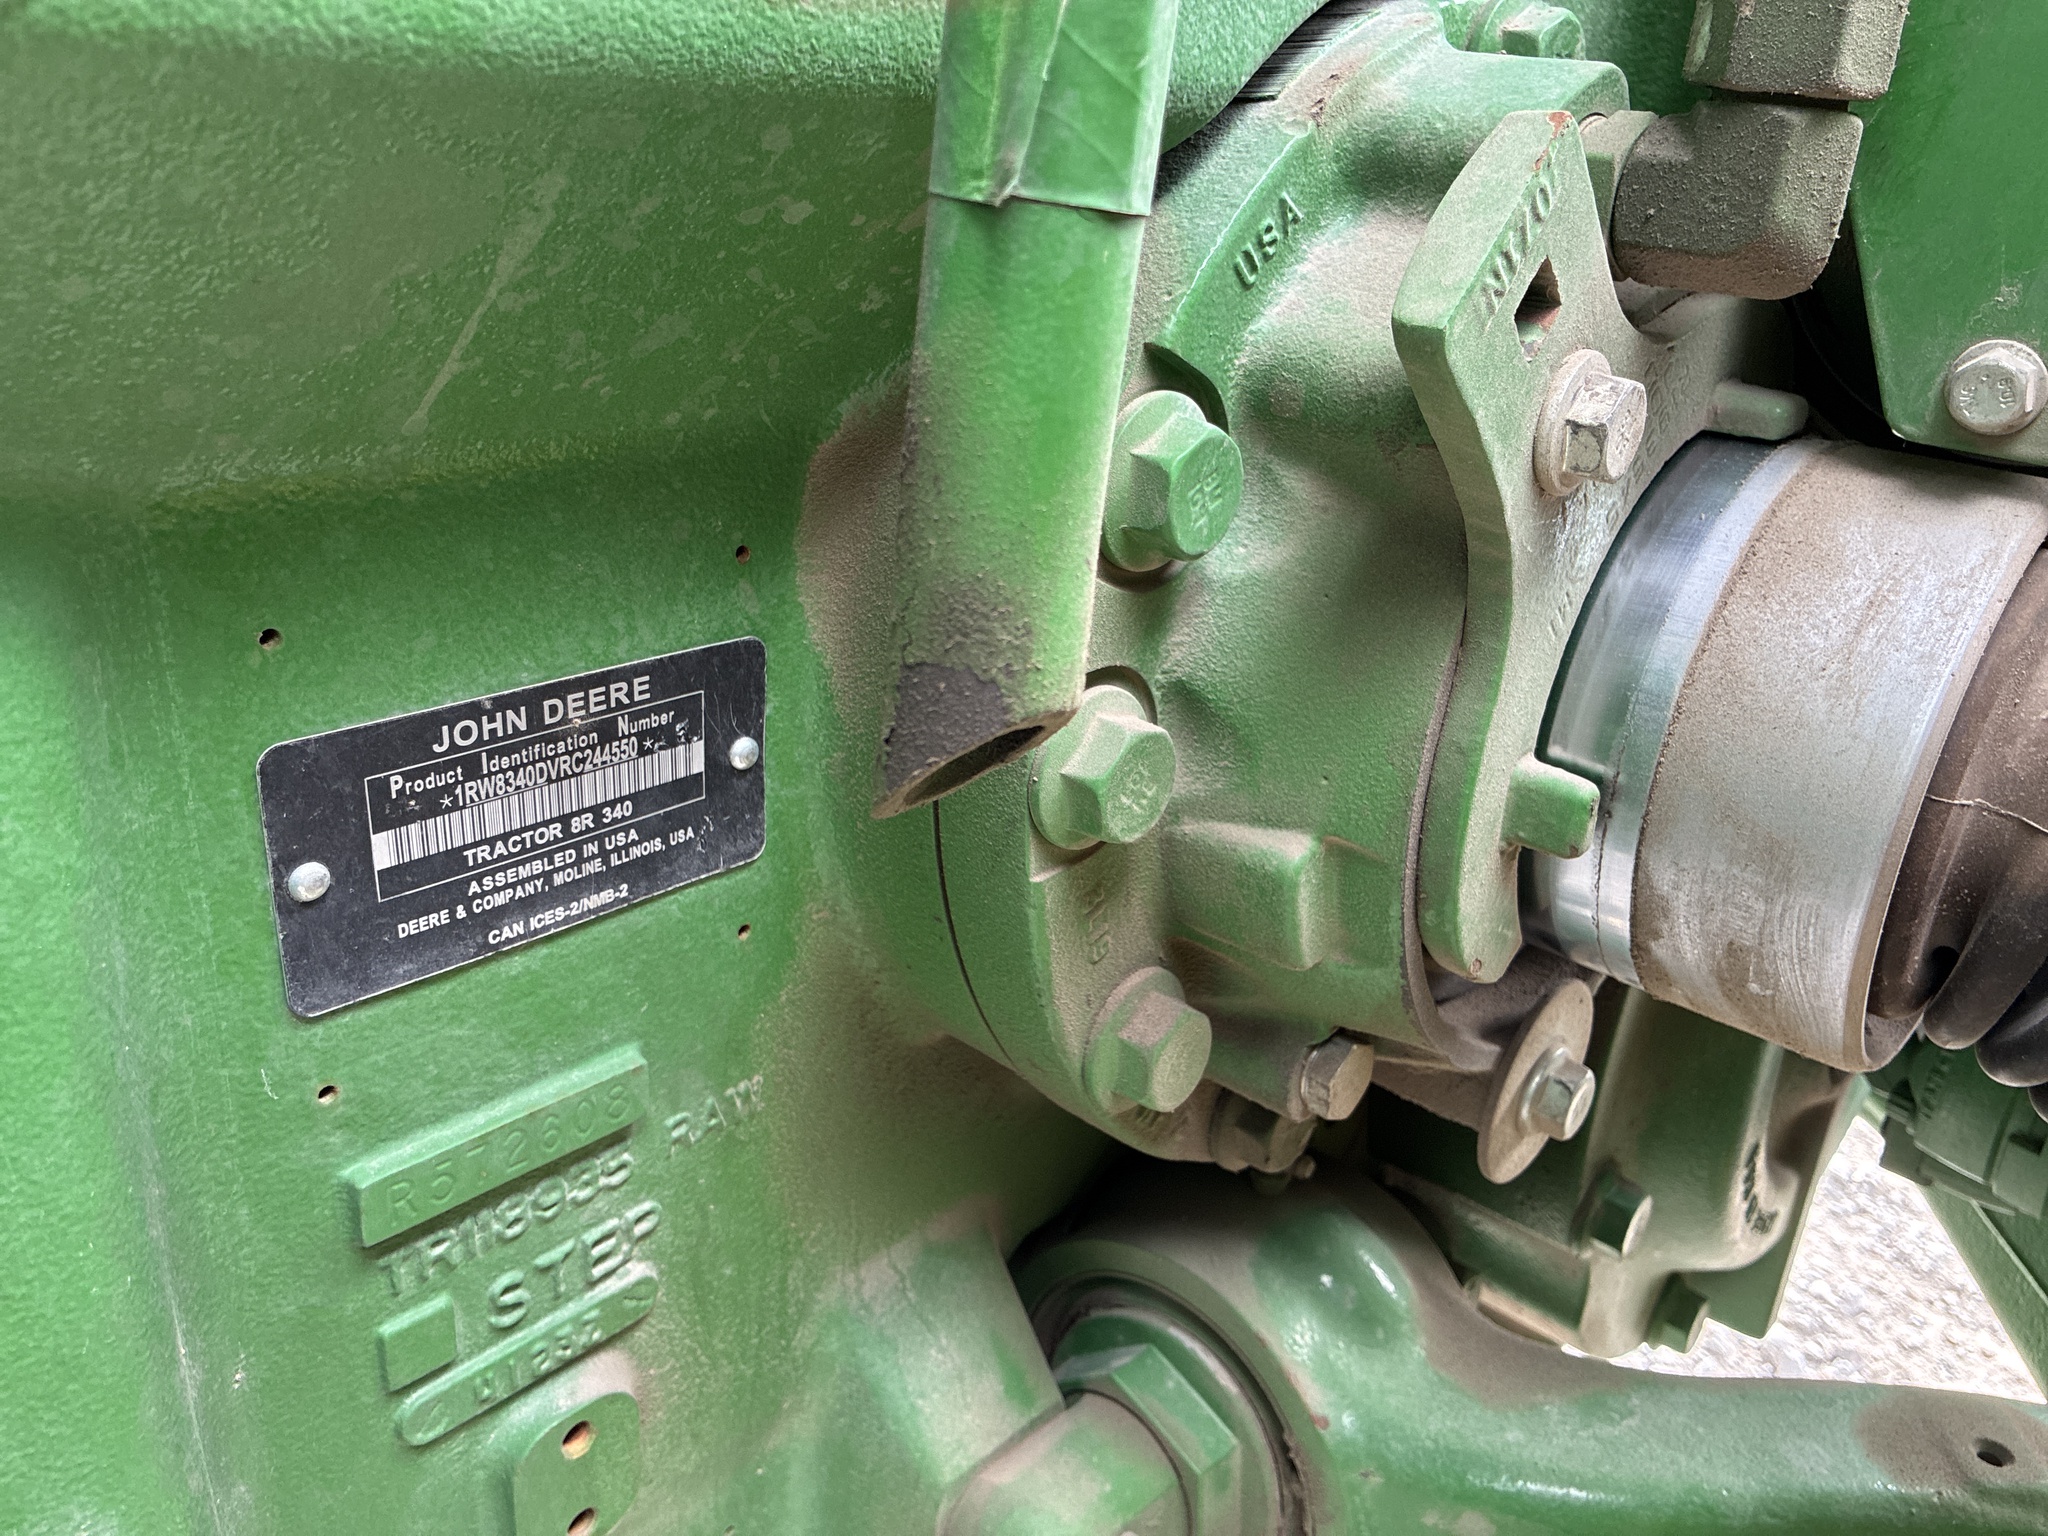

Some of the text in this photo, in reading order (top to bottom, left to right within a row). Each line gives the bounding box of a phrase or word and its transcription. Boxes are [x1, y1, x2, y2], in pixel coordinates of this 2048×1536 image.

[1233, 191, 1304, 290] USA
[389, 710, 675, 800] Product Identification Number
[432, 675, 651, 753] JOHN DEERE
[463, 800, 633, 867] TRACTOR 8R 340
[468, 828, 639, 896] ASSEMBLED IN USA
[398, 826, 695, 939] DEERE & COMPANY, MOLINE, ILLINOIS, USA
[488, 883, 629, 944] CAN ICES-2/NMB-2
[384, 1083, 632, 1226] R572608
[486, 1199, 662, 1330] STEP
